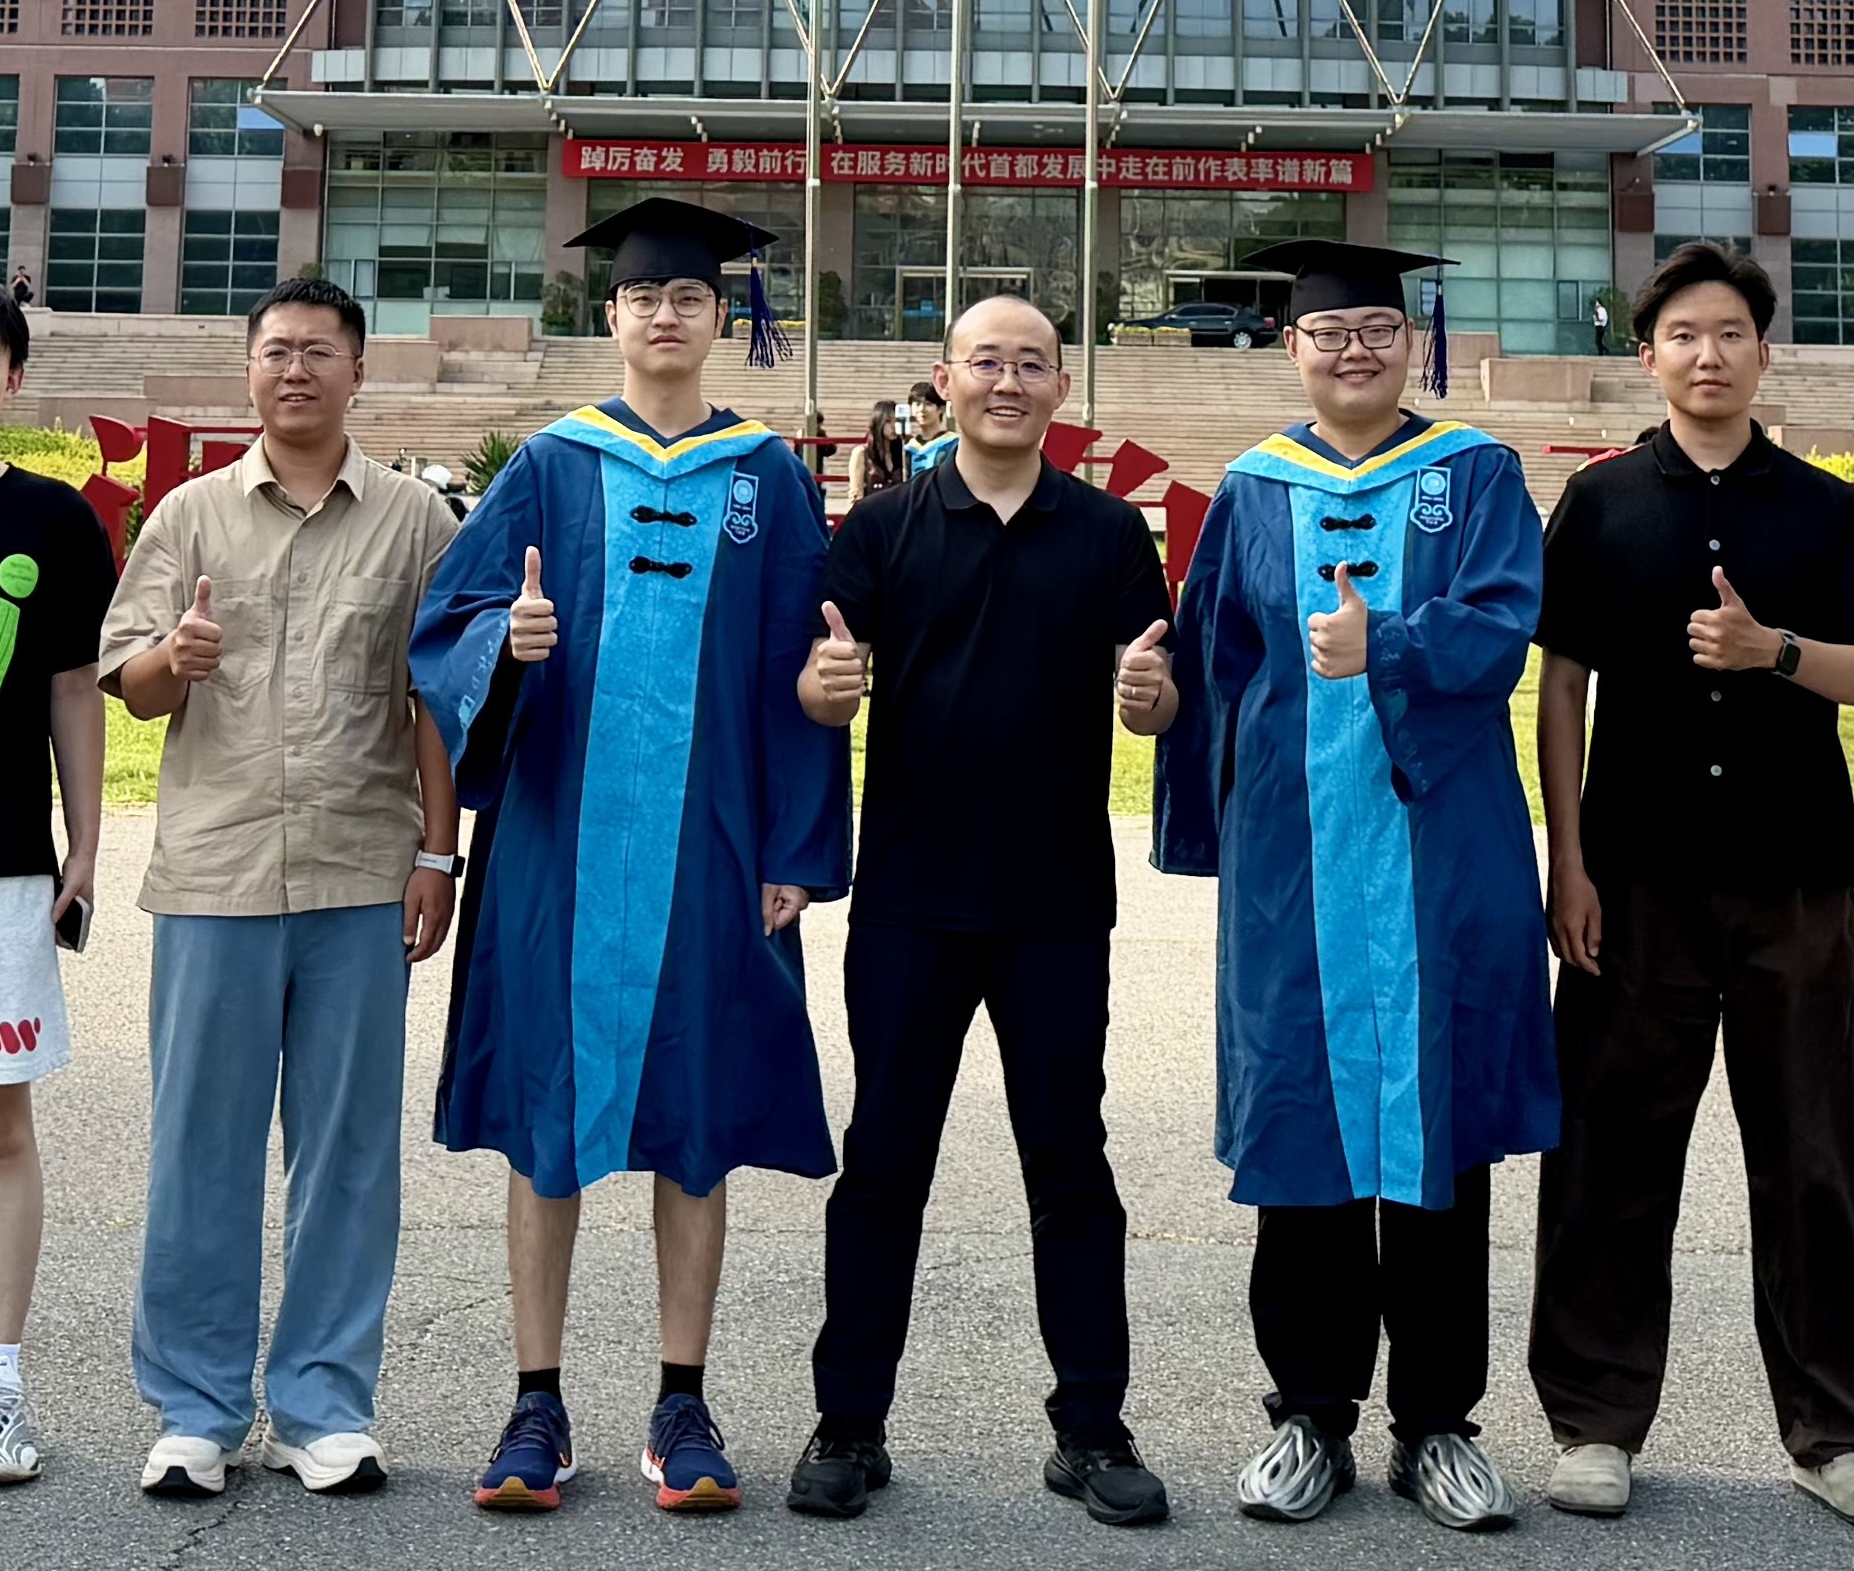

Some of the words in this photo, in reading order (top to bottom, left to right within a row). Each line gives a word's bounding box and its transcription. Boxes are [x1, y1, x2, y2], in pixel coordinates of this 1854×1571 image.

[580, 146, 685, 174] 踔厉奋发
[706, 147, 808, 176] 勇毅前行
